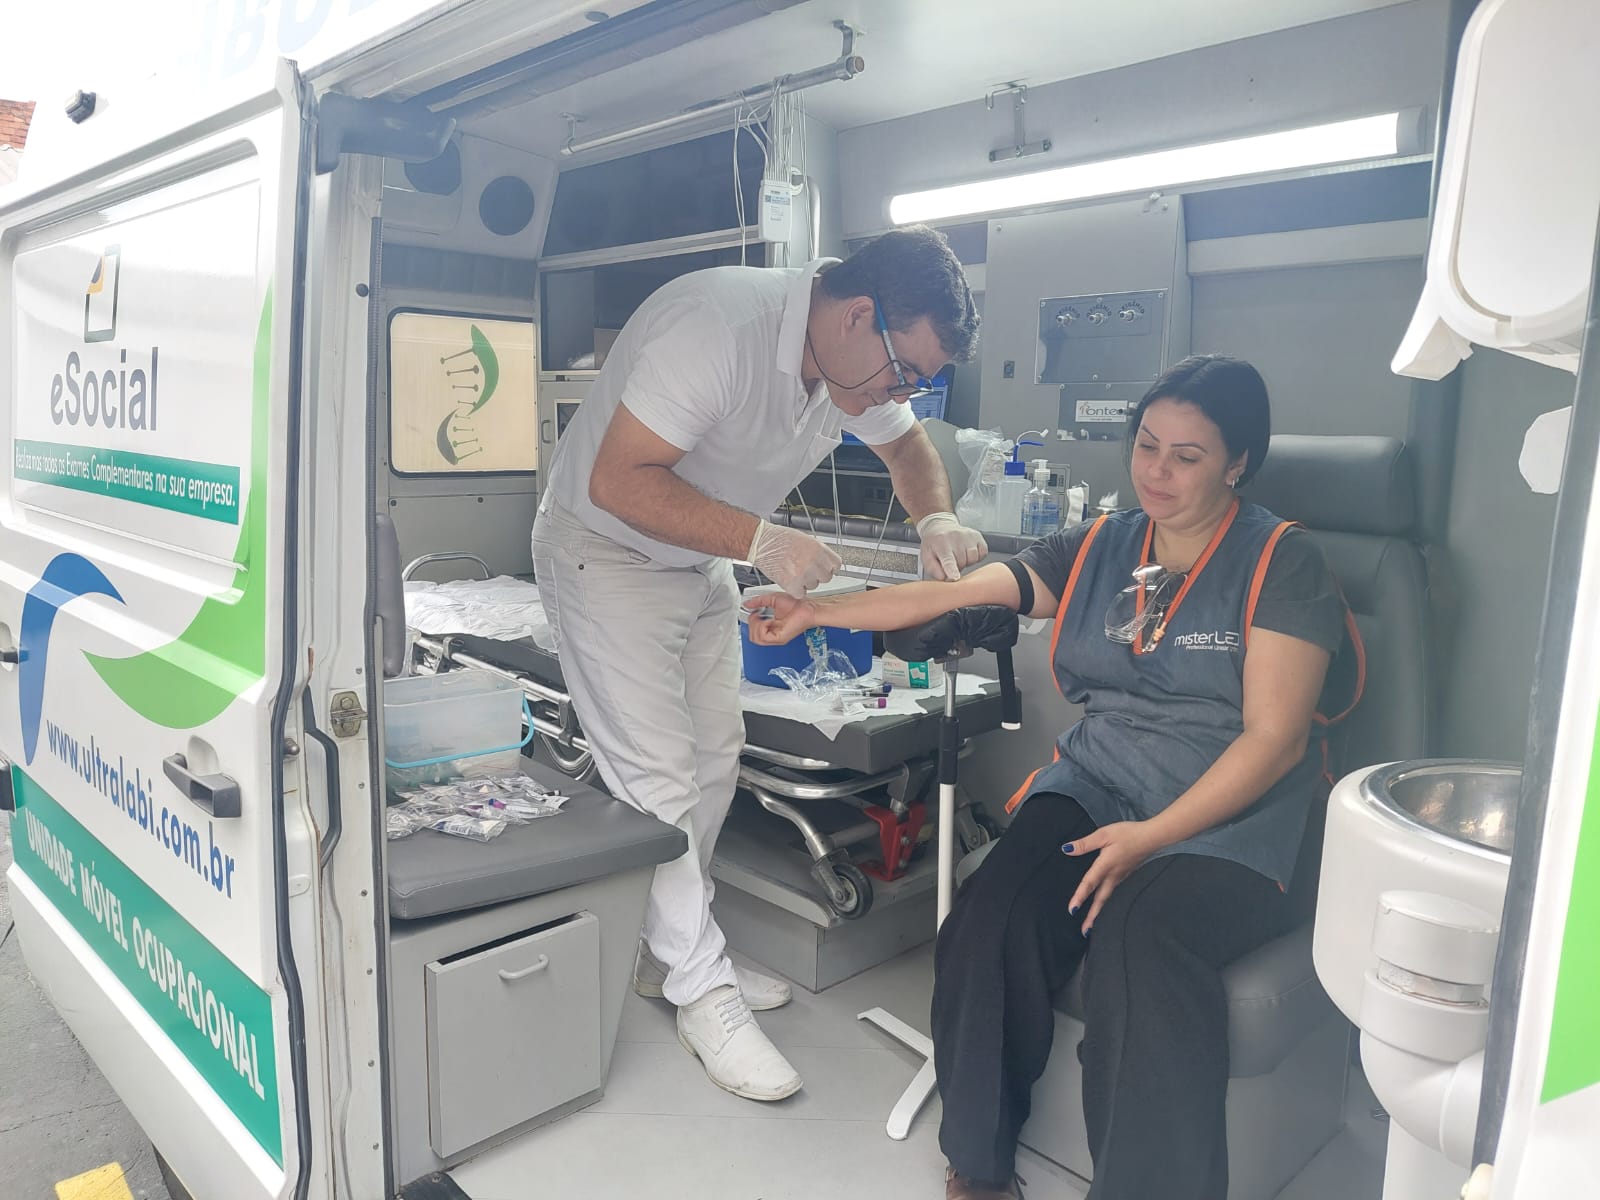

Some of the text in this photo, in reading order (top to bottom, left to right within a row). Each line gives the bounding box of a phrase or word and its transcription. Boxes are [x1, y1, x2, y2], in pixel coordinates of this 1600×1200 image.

[50, 346, 159, 431] eSocial
[58, 458, 65, 475] os
[66, 451, 90, 480] Exames
[91, 453, 153, 492] Complementares
[155, 472, 167, 494] na
[169, 474, 186, 498] sua
[188, 478, 236, 510] empresa.
[47, 719, 235, 899] www.ultralabi.com.br
[25, 807, 266, 1101] UNIDADE MÓVEL OCUPACIONAL
